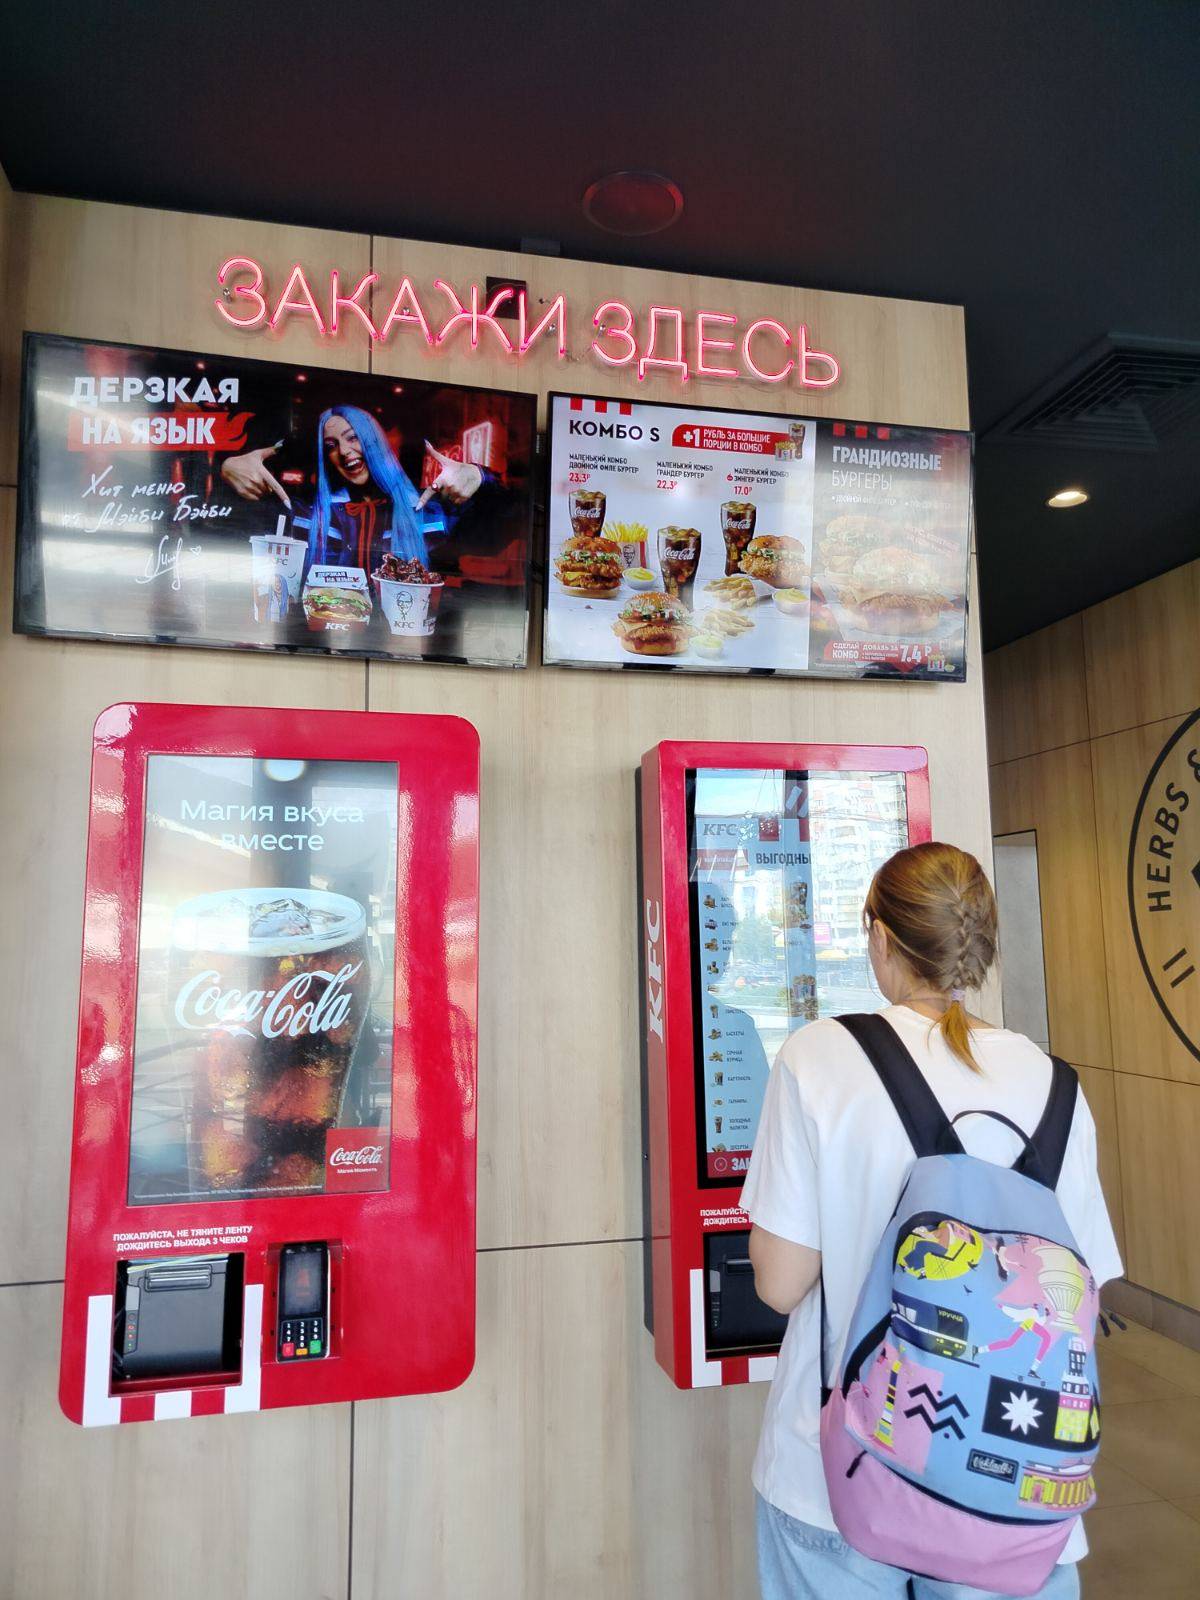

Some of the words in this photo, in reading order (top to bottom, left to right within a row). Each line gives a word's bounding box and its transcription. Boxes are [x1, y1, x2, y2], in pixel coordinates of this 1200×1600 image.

[216, 257, 567, 360] ЗАКАЖИ
[593, 302, 841, 388] ЗДЕСЬ
[70, 376, 240, 407] ДЕРЗКАЯ
[82, 417, 121, 445] НА
[131, 417, 216, 445] ЯЗЫК
[569, 420, 643, 440] КОМБО
[650, 427, 660, 442] S
[683, 428, 699, 446] +1
[703, 429, 726, 439] РУБЛЬ
[727, 431, 736, 440] ЗА
[737, 432, 771, 443] БОЛЬШИЕ
[703, 440, 732, 451] ПОРЦИИ
[733, 442, 738, 450] В
[739, 443, 762, 453] КОМБО
[569, 453, 606, 462] МАЛЕНЬКИЙ
[607, 457, 628, 465] КОМБО
[656, 461, 692, 470] МАЛЕНЬКИЙ
[693, 464, 713, 472] КОМБО
[833, 446, 942, 471] ГРАНДИОЗНЫЕ
[569, 461, 598, 470] ДВОЙНОЙ
[617, 466, 639, 474] БУРГЕР
[656, 469, 682, 478] ГРАНДЕР
[683, 471, 705, 479] БУРГЕР
[734, 467, 768, 476] МАЛЕНЬКИЙ
[82, 465, 123, 498] Хит
[734, 475, 755, 483] ЗИНГЕР
[757, 477, 777, 485] БУРГЕР
[832, 470, 892, 490] БУРГЕРЫ
[325, 622, 351, 631] KFC
[394, 620, 415, 629] KFC
[832, 650, 859, 660] КОМБО
[180, 800, 274, 823] Магия
[284, 804, 365, 826] вкуса
[704, 823, 738, 836] KFC
[221, 834, 325, 852] вместе
[1146, 782, 1190, 912] HERBS
[646, 898, 664, 1044] KFC
[174, 959, 364, 1039] Coca-Cola
[330, 1145, 385, 1166] Coca-Cola
[703, 1216, 747, 1226] ДОЖДИТЕСЬ
[113, 1230, 175, 1242] ПОЖАЛУЙСТА,
[177, 1229, 189, 1238] НЕ
[191, 1227, 223, 1236] ТЯНИТЕ
[224, 1226, 253, 1235] ЛЕНТУ
[116, 1241, 172, 1252] ДОЖДИТЕСЬ
[174, 1238, 211, 1248] ВЫХОДА
[219, 1236, 248, 1245] ЧЕКОВ
